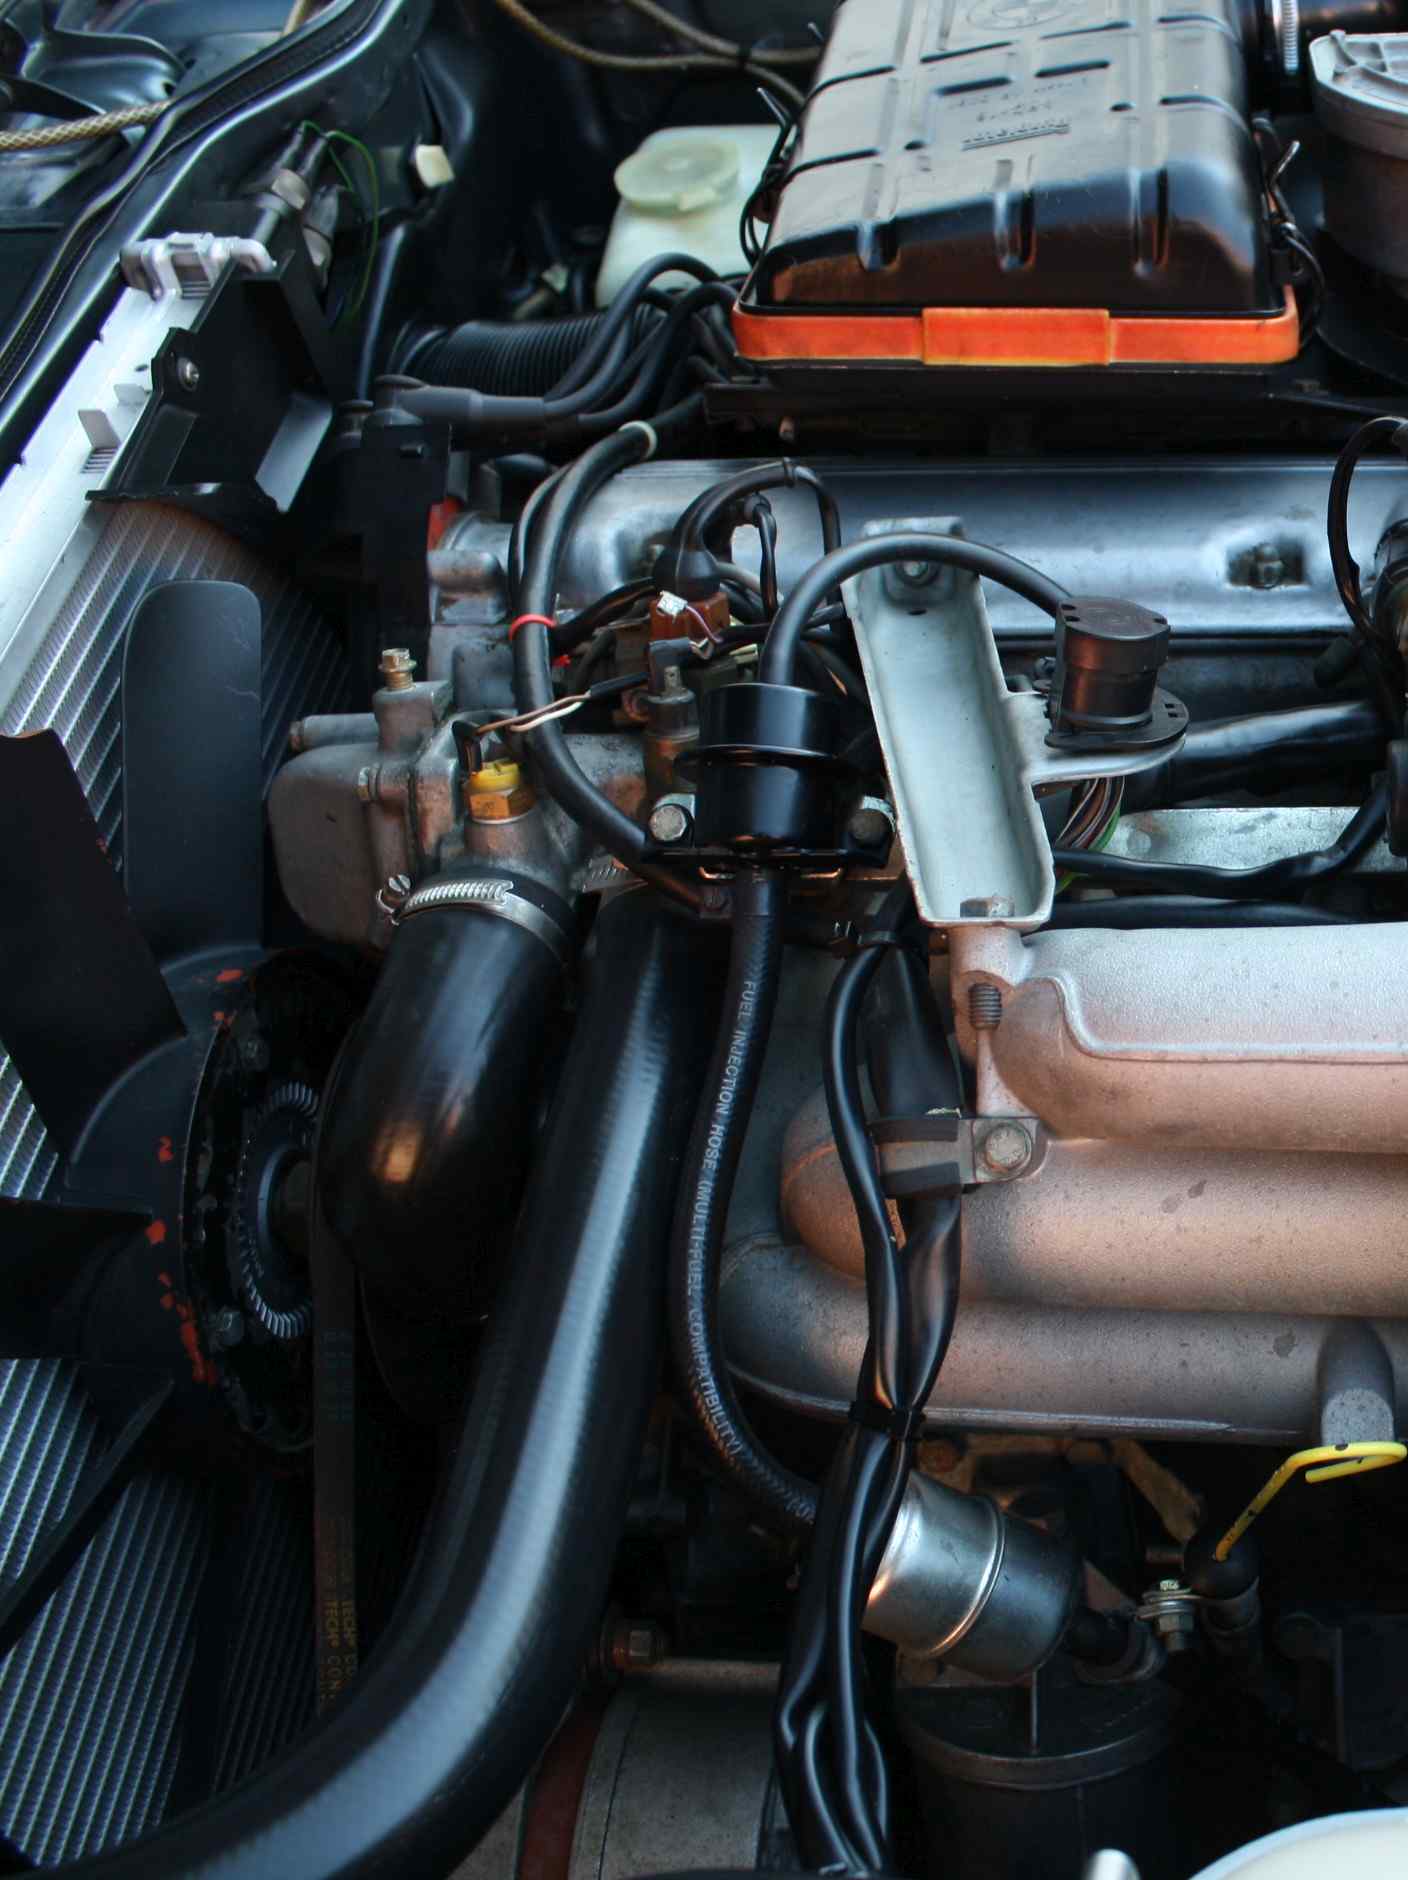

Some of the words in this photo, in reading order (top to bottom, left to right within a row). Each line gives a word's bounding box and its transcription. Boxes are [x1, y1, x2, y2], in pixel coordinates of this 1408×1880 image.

[738, 980, 757, 1020] FUEL
[714, 1029, 748, 1114] INJECTION
[703, 1123, 726, 1170] HOSE
[687, 1180, 714, 1297] (MULTI-FUEL
[688, 1307, 744, 1455] COMPATIBILITY)
